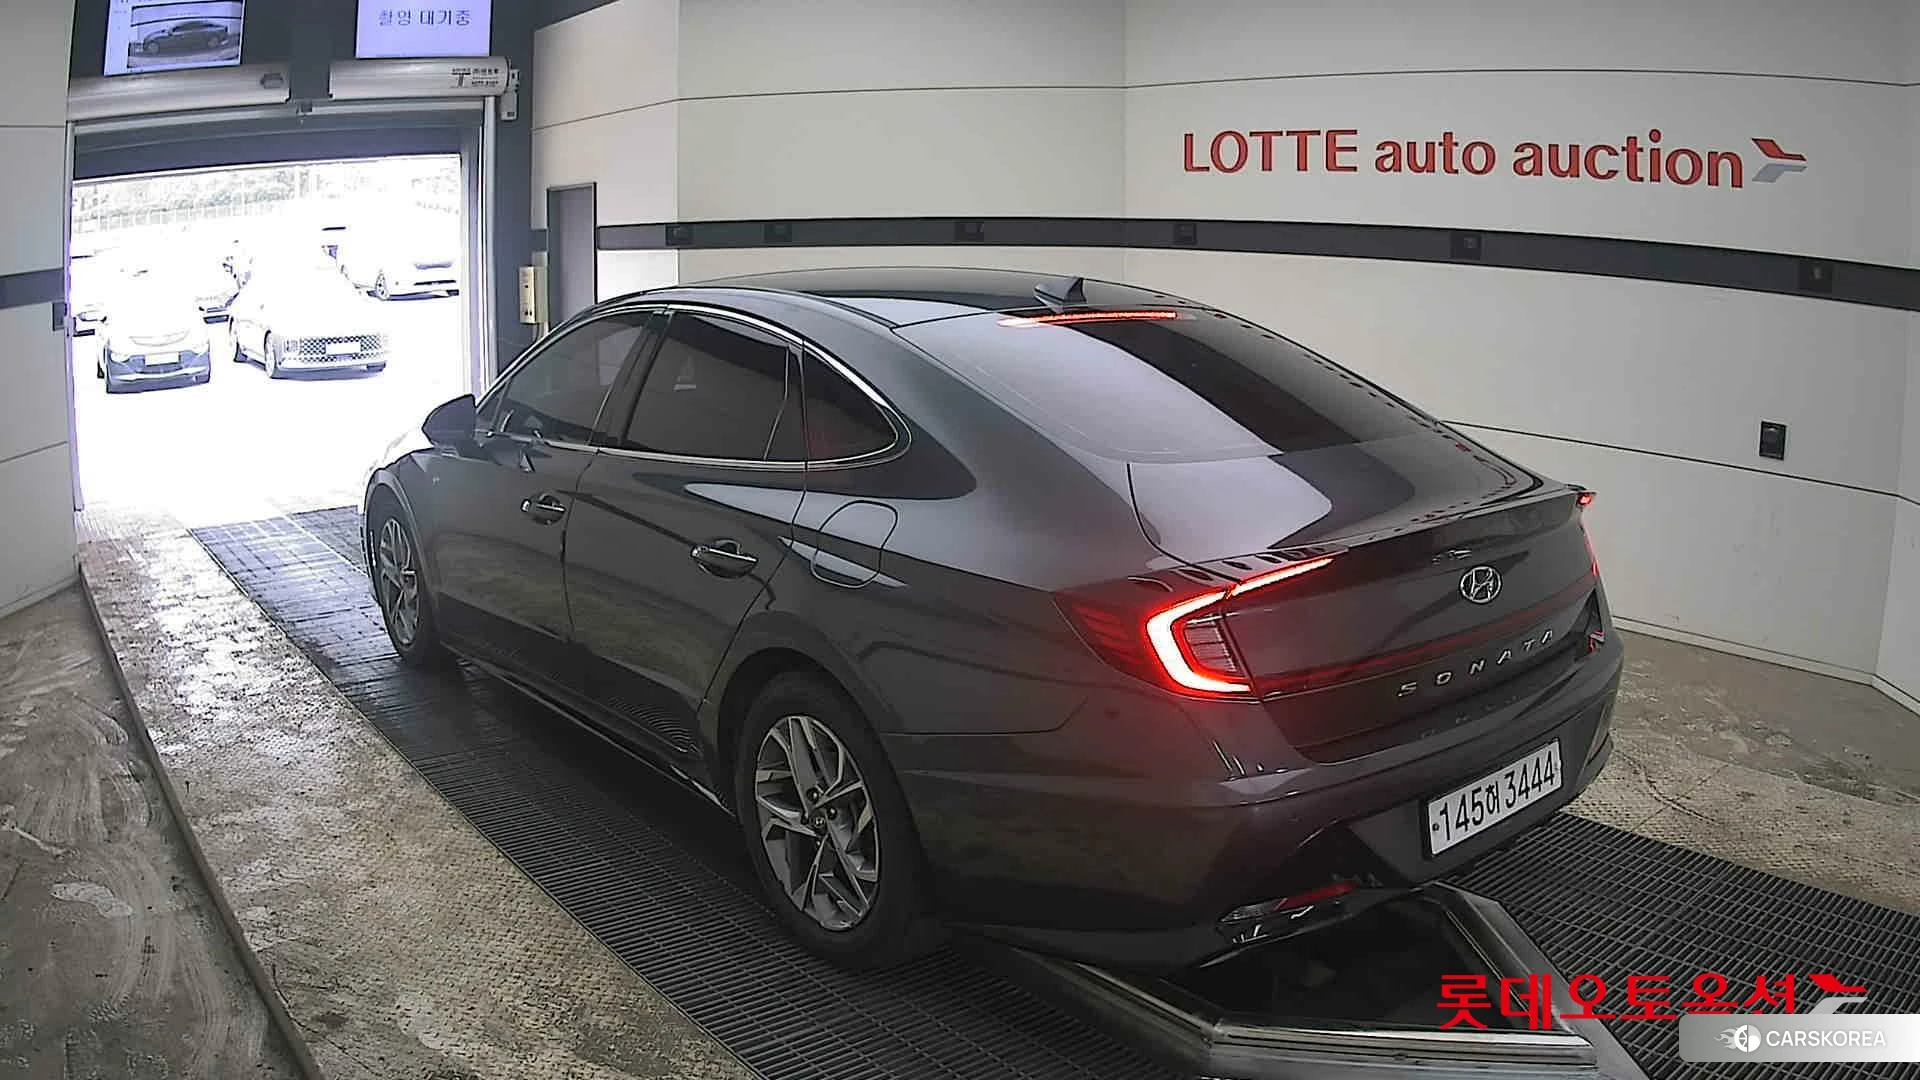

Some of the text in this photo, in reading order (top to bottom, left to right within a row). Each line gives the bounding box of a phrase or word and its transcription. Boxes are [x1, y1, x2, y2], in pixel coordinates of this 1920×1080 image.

[420, 9, 470, 26] 대기중
[1184, 130, 1743, 188] LOTTE auto auction
[1398, 629, 1553, 697] SONATA
[1439, 750, 1555, 841] 145허 3444
